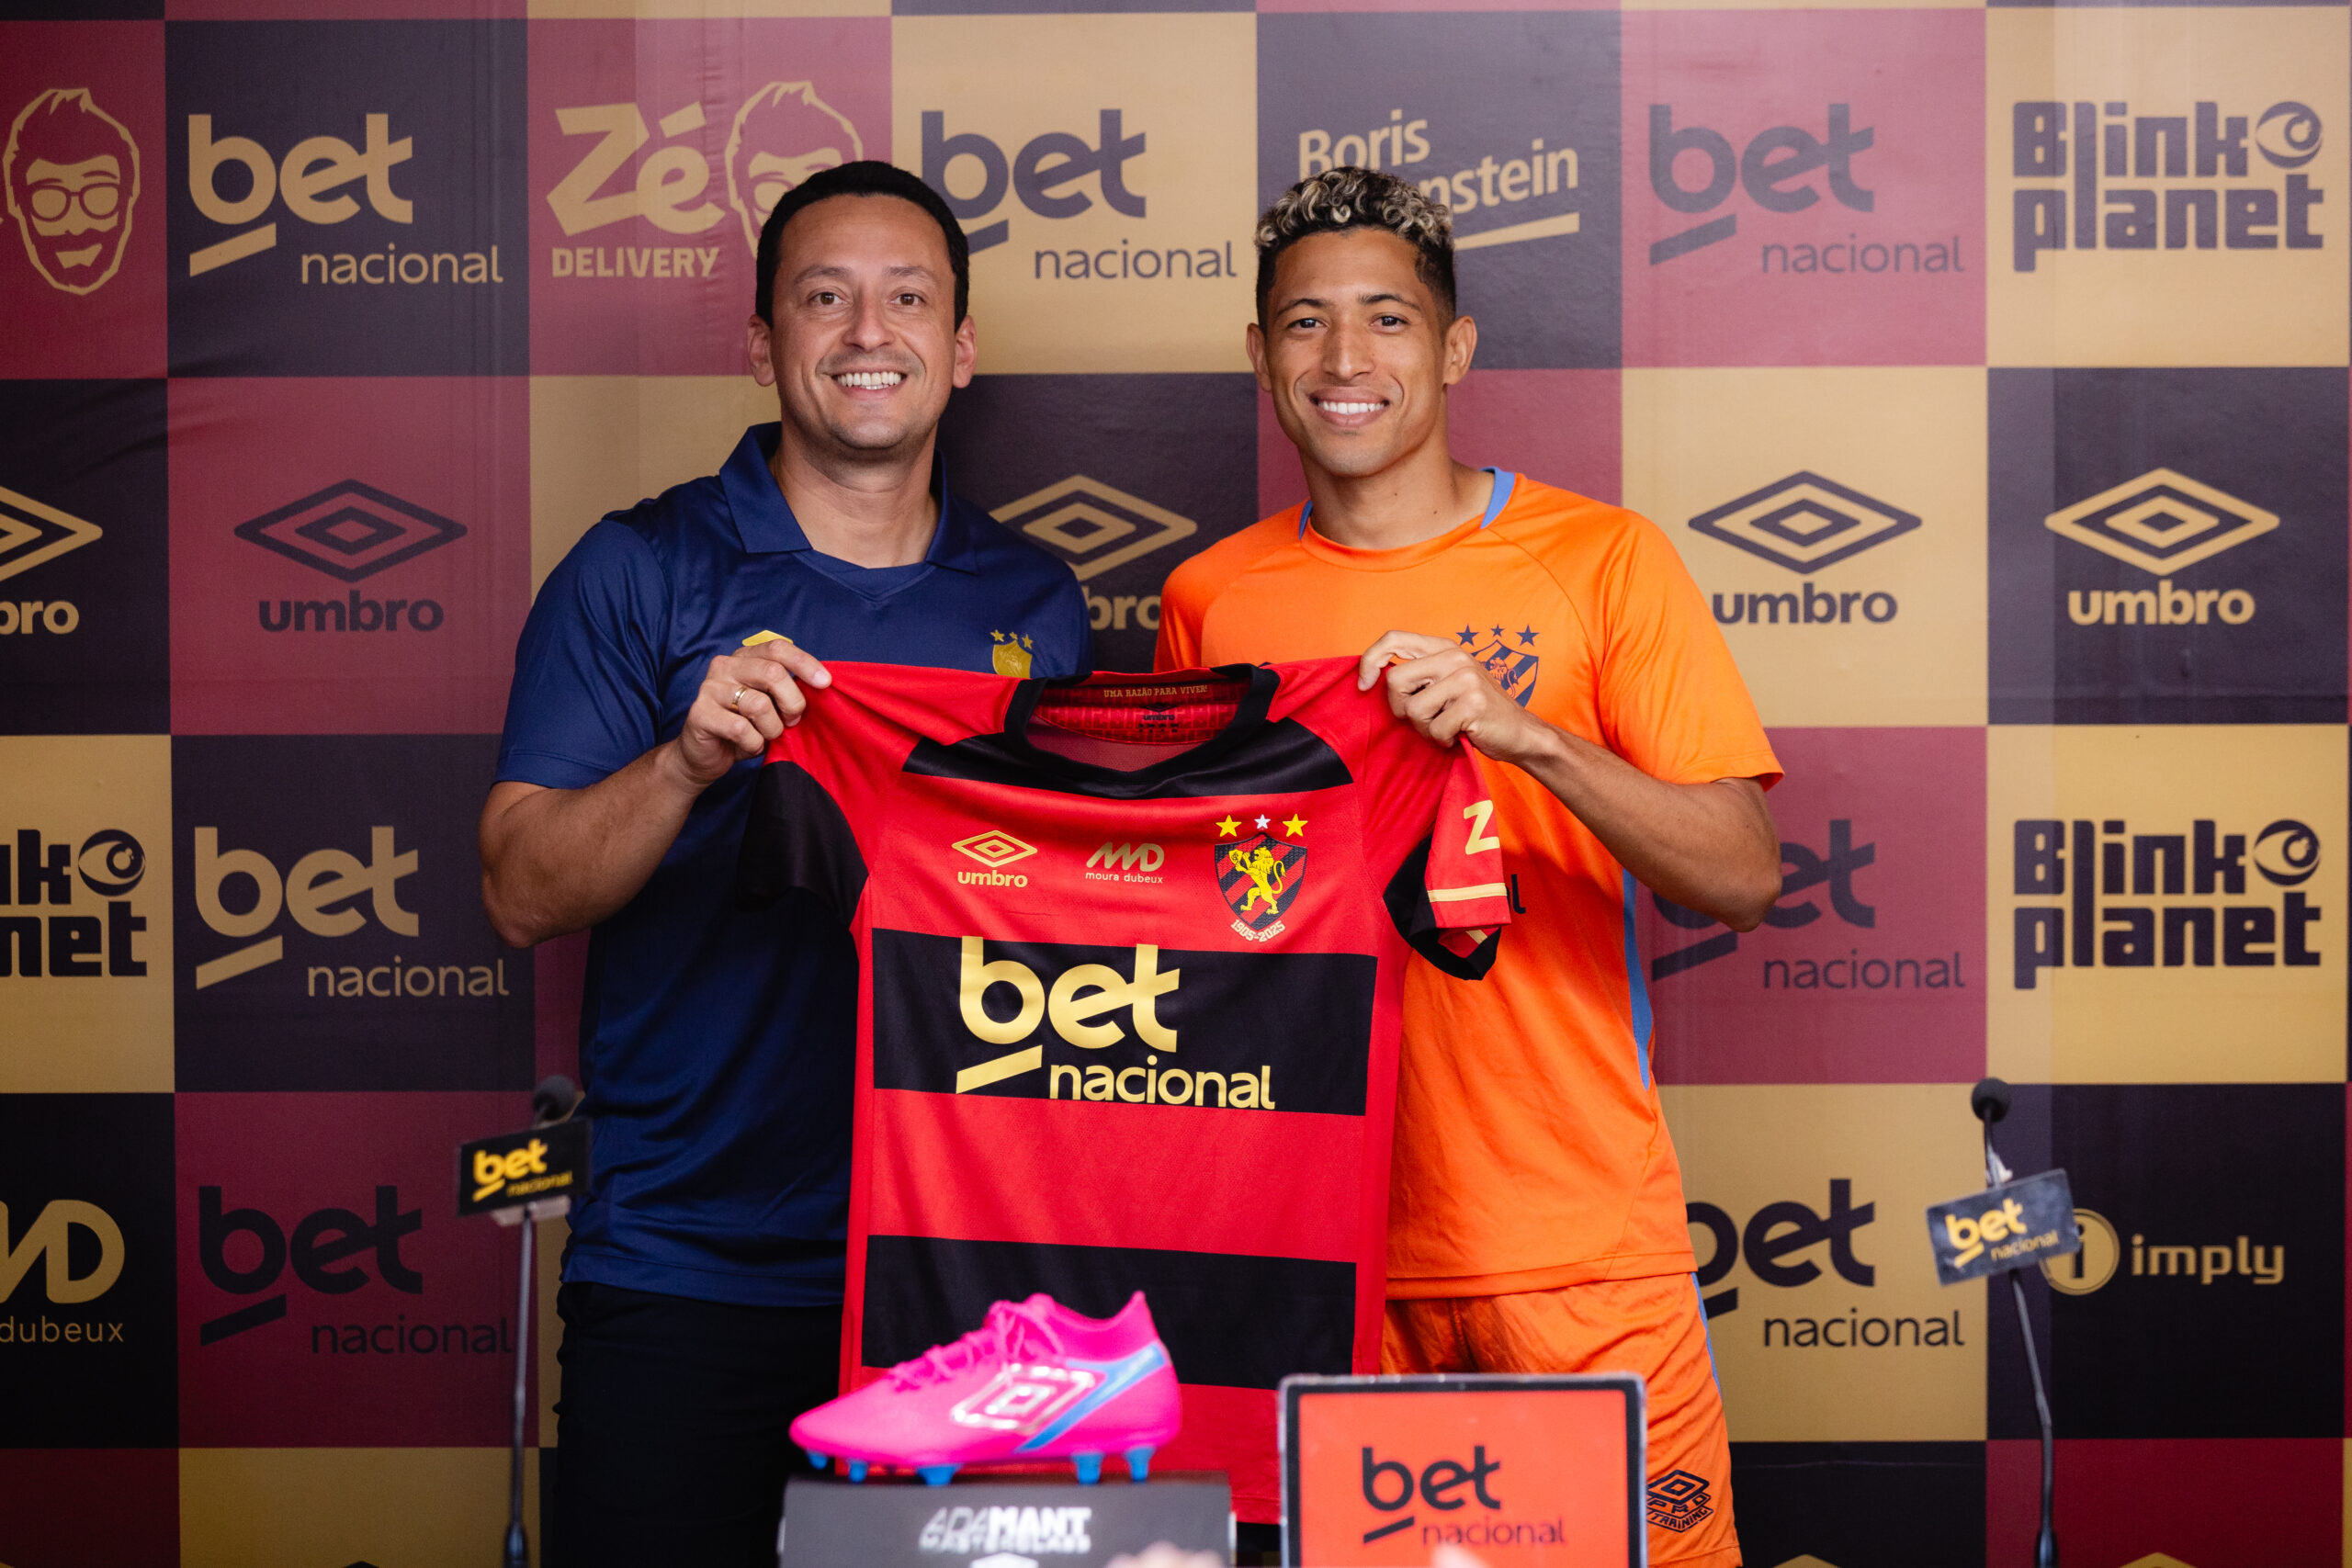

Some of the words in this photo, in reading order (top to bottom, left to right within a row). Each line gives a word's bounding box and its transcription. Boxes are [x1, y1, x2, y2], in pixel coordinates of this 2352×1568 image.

[1299, 108, 1430, 184] Boris
[1648, 103, 1874, 213] bet
[2013, 101, 2248, 178] Blink
[188, 113, 413, 224] bet
[546, 101, 726, 237] Zé
[922, 108, 1147, 220] bet
[1419, 138, 1578, 215] nstein
[2013, 173, 2324, 273] planet
[300, 243, 503, 284] nacional
[551, 247, 719, 278] DELIVERY
[1034, 239, 1238, 280] nacional
[1761, 233, 1965, 274] nacional
[258, 590, 444, 634] umbro
[1084, 585, 1161, 631] bro
[1712, 581, 1898, 625] umbro
[2068, 580, 2256, 626] umbro
[1154, 687, 1177, 695] PARA
[1143, 712, 1175, 720] umbro
[957, 870, 1028, 888] umbro
[1085, 871, 1120, 882] moura
[1124, 873, 1164, 884] dubeux
[2014, 819, 2246, 895] Blink
[195, 827, 419, 937] bet
[0, 901, 148, 977] net
[1230, 919, 1285, 942] 1905-2025
[2014, 891, 2322, 990] planet
[307, 954, 510, 998] nacional
[1763, 948, 1965, 989] nacional
[959, 935, 1181, 1053] bet
[1049, 1055, 1275, 1111] nacional
[473, 1138, 548, 1186] bet
[198, 1185, 424, 1295] bet
[1945, 1197, 2028, 1250] bet
[1990, 1229, 2060, 1261] nacional
[2131, 1234, 2285, 1284] imply
[0, 1315, 124, 1343] dubeux
[311, 1314, 513, 1355] nacional
[1763, 1306, 1965, 1348] nacional
[1362, 1445, 1501, 1512] bet
[922, 1506, 1092, 1537] ADAMANT
[1647, 1494, 1708, 1515] PRO
[1651, 1507, 1708, 1529] TRAINING
[1422, 1516, 1566, 1545] nacional
